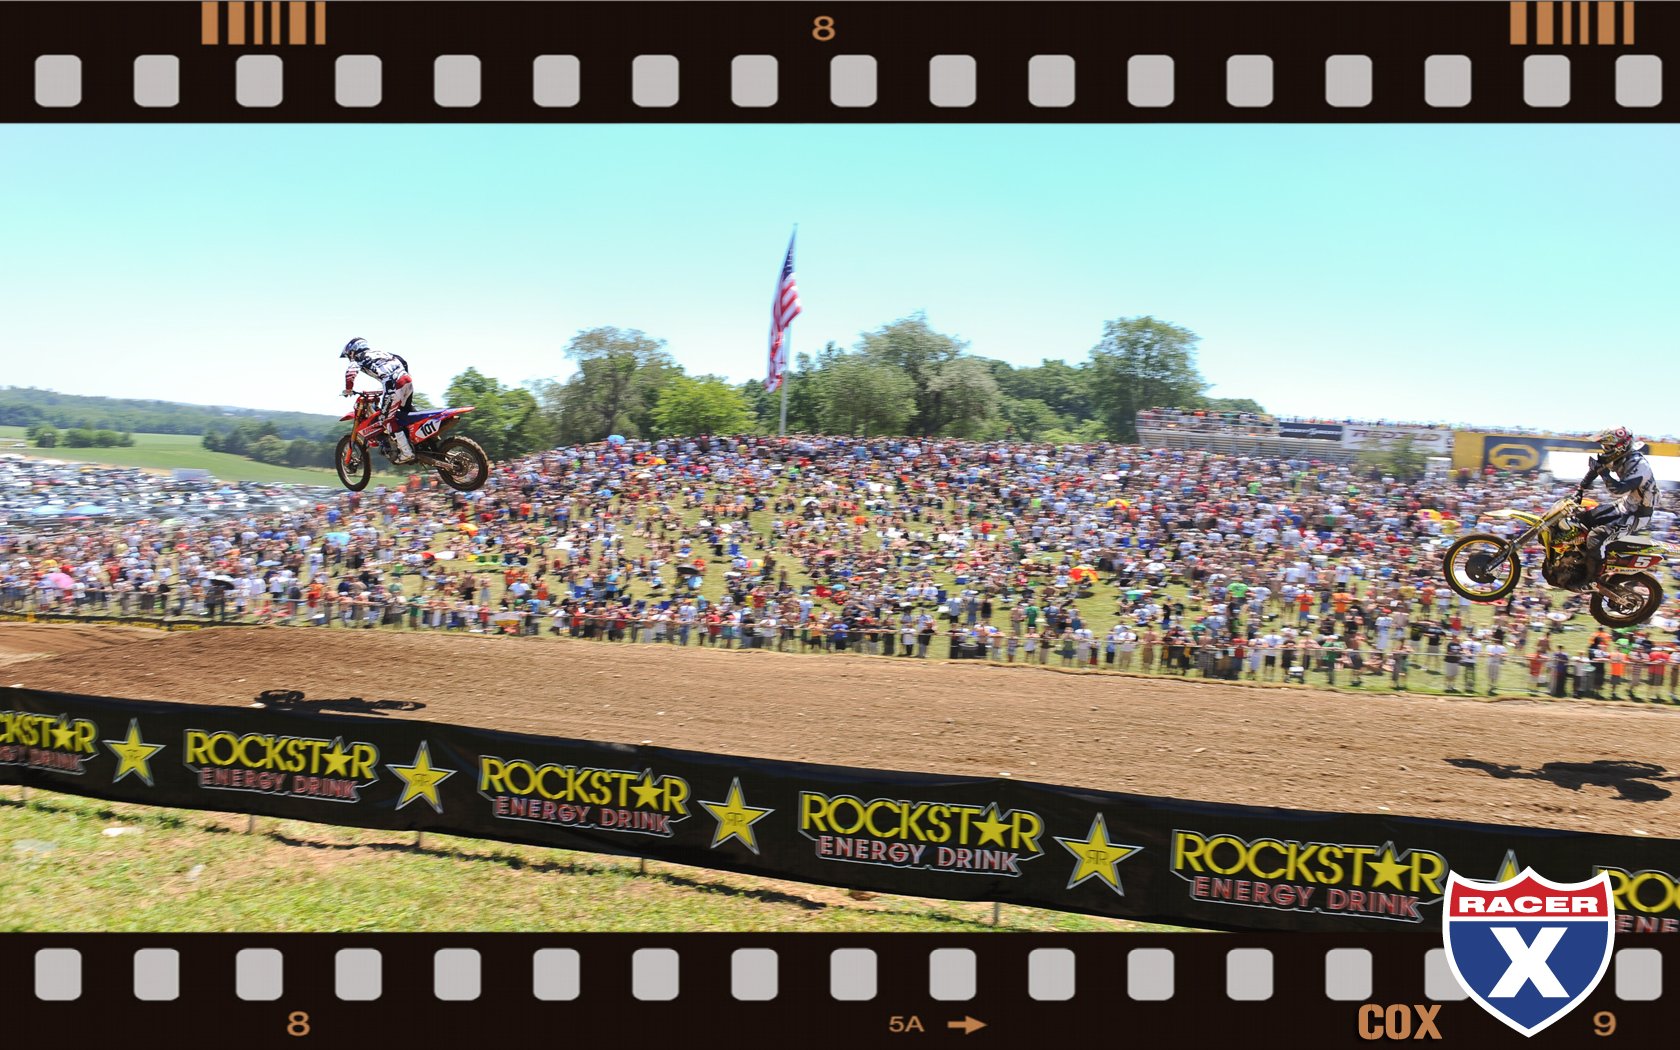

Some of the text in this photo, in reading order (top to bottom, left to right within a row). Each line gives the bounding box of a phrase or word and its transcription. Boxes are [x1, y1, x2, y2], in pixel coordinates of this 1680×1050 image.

[419, 421, 438, 437] 101
[1633, 556, 1652, 568] 5
[186, 731, 378, 779] ROCKSTAR
[202, 766, 359, 799] ENERGY DRINK
[480, 757, 688, 815] ROCKSTAR
[495, 795, 672, 834] ENERGY DRINK
[801, 793, 1042, 853] ROCKSTAR
[818, 835, 1020, 873] ENERGY DRINK
[1174, 832, 1445, 895] ROCKSTAR
[1193, 875, 1420, 918] ENERGY DRINK
[1597, 868, 1680, 913] RO
